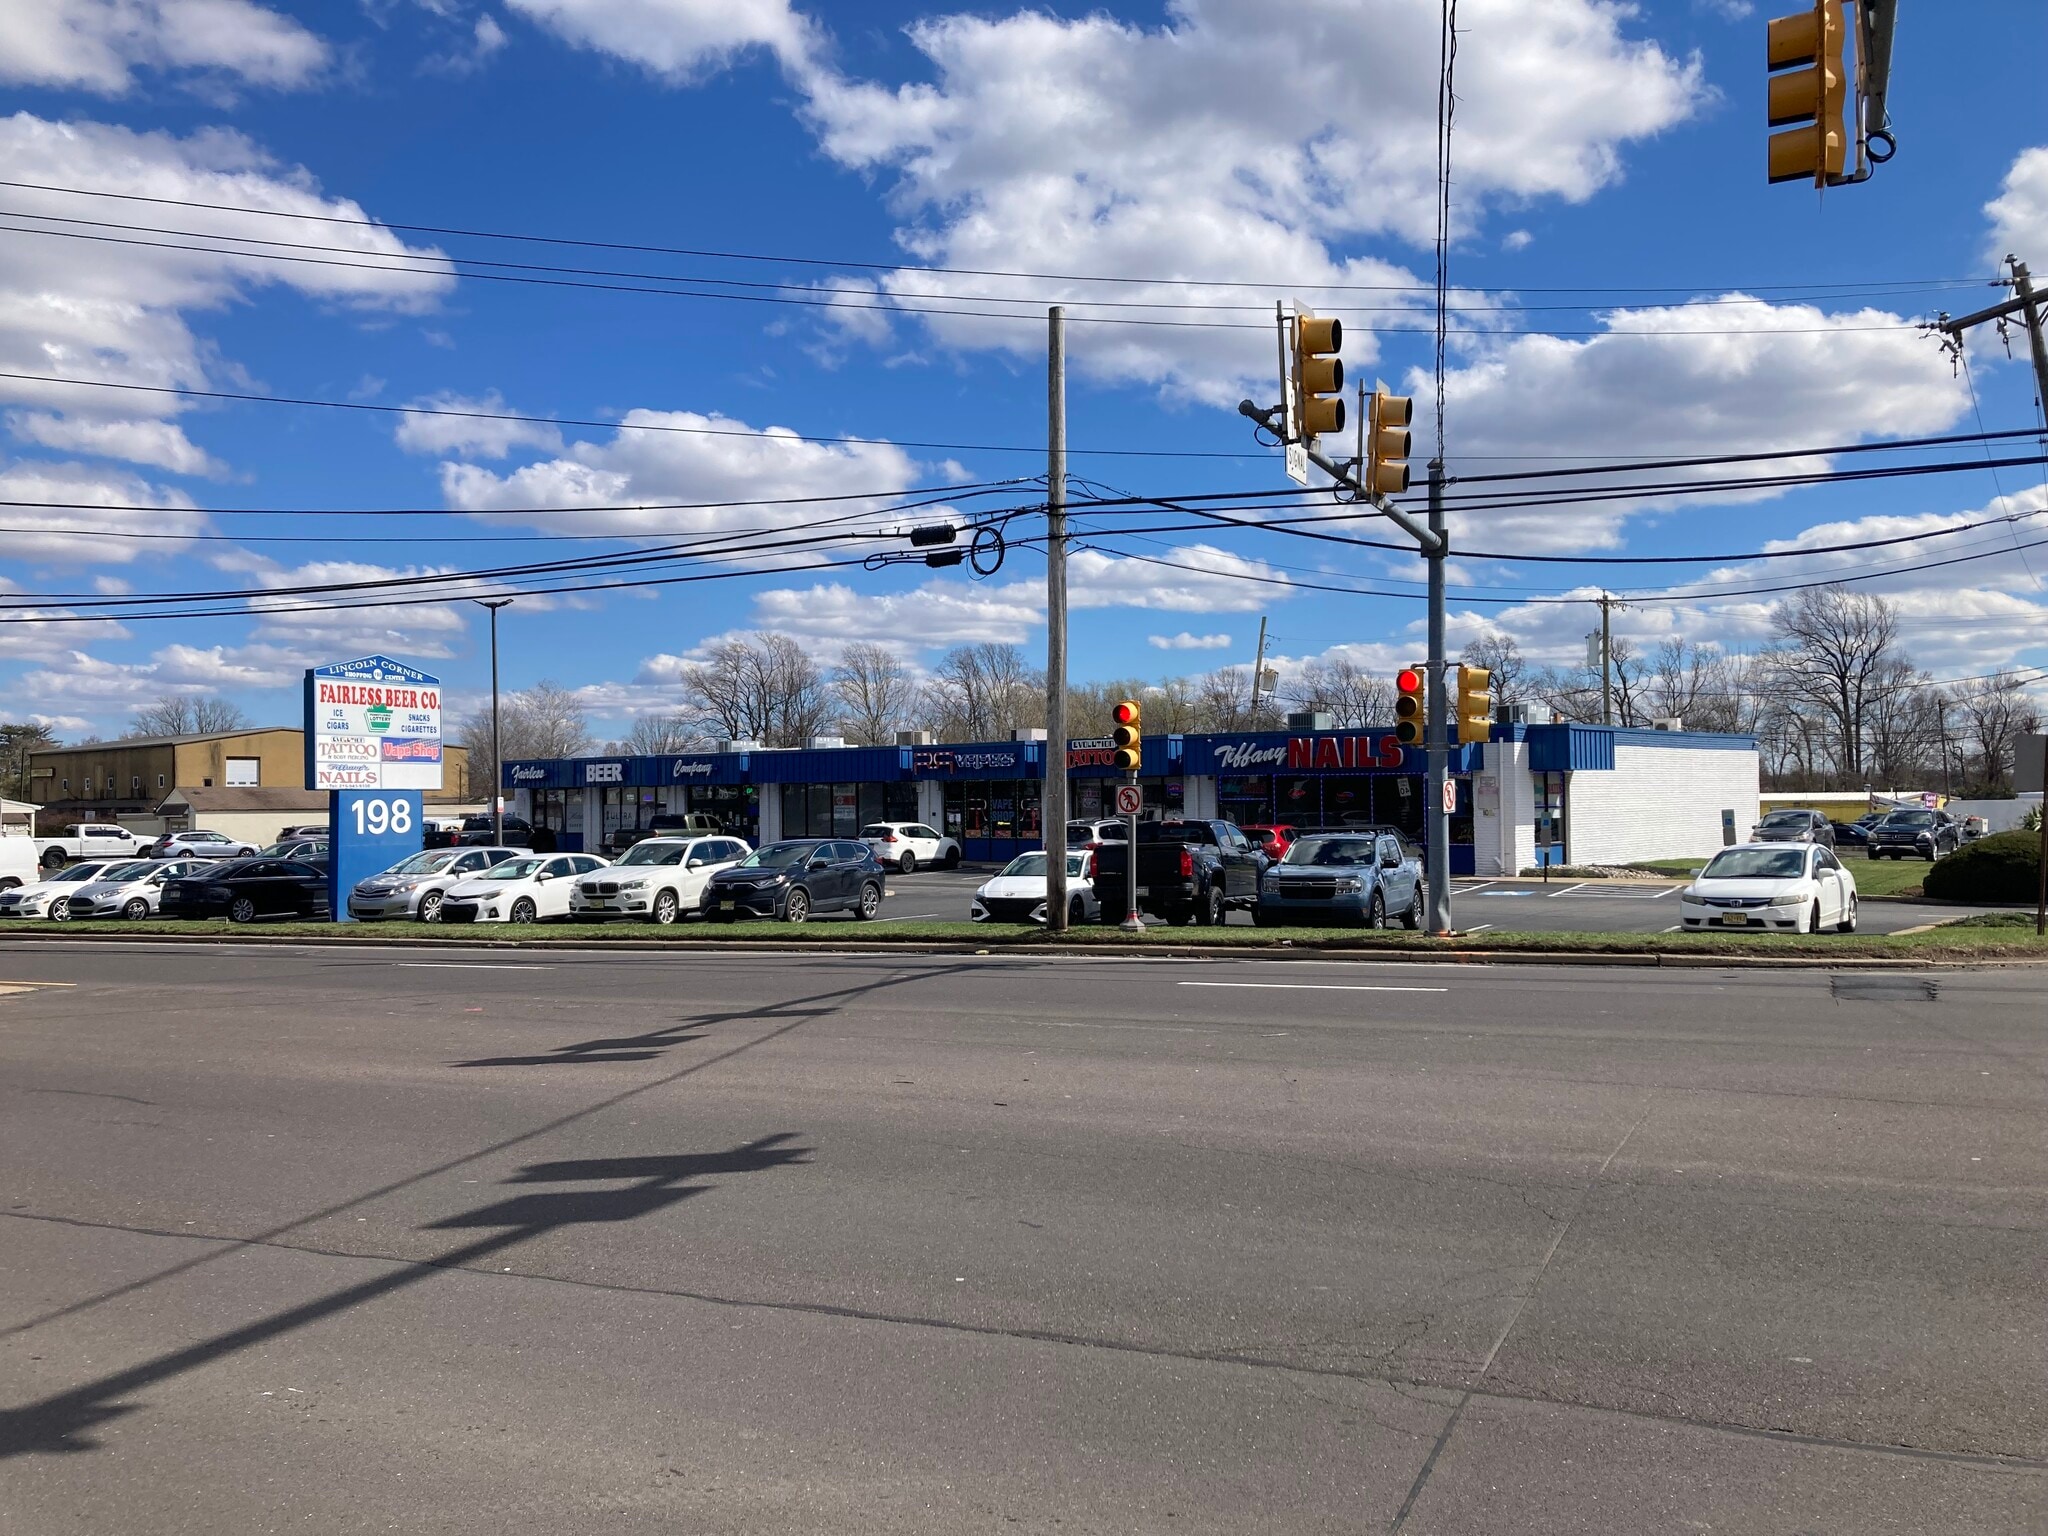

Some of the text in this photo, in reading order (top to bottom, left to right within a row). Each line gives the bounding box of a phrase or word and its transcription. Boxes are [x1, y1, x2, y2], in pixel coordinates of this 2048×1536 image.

[329, 659, 423, 681] LINCOLN CORNER
[344, 671, 373, 679] SHOPPING
[320, 684, 441, 710] FAIRLESS BEER CO.
[333, 709, 344, 717] ICE
[408, 713, 431, 722] SNACKS
[326, 721, 349, 730] CIGARS
[401, 725, 437, 734] CIGARETTES
[318, 742, 378, 758] TATTOO
[383, 742, 440, 760] Vape Shop
[1213, 734, 1405, 769] Tiffany NAILS
[318, 771, 378, 784] NAILS
[511, 759, 712, 785] Fairless BEER Company
[991, 799, 1013, 809] VAPE
[351, 798, 412, 835] 198
[991, 810, 1015, 821] SHOP
